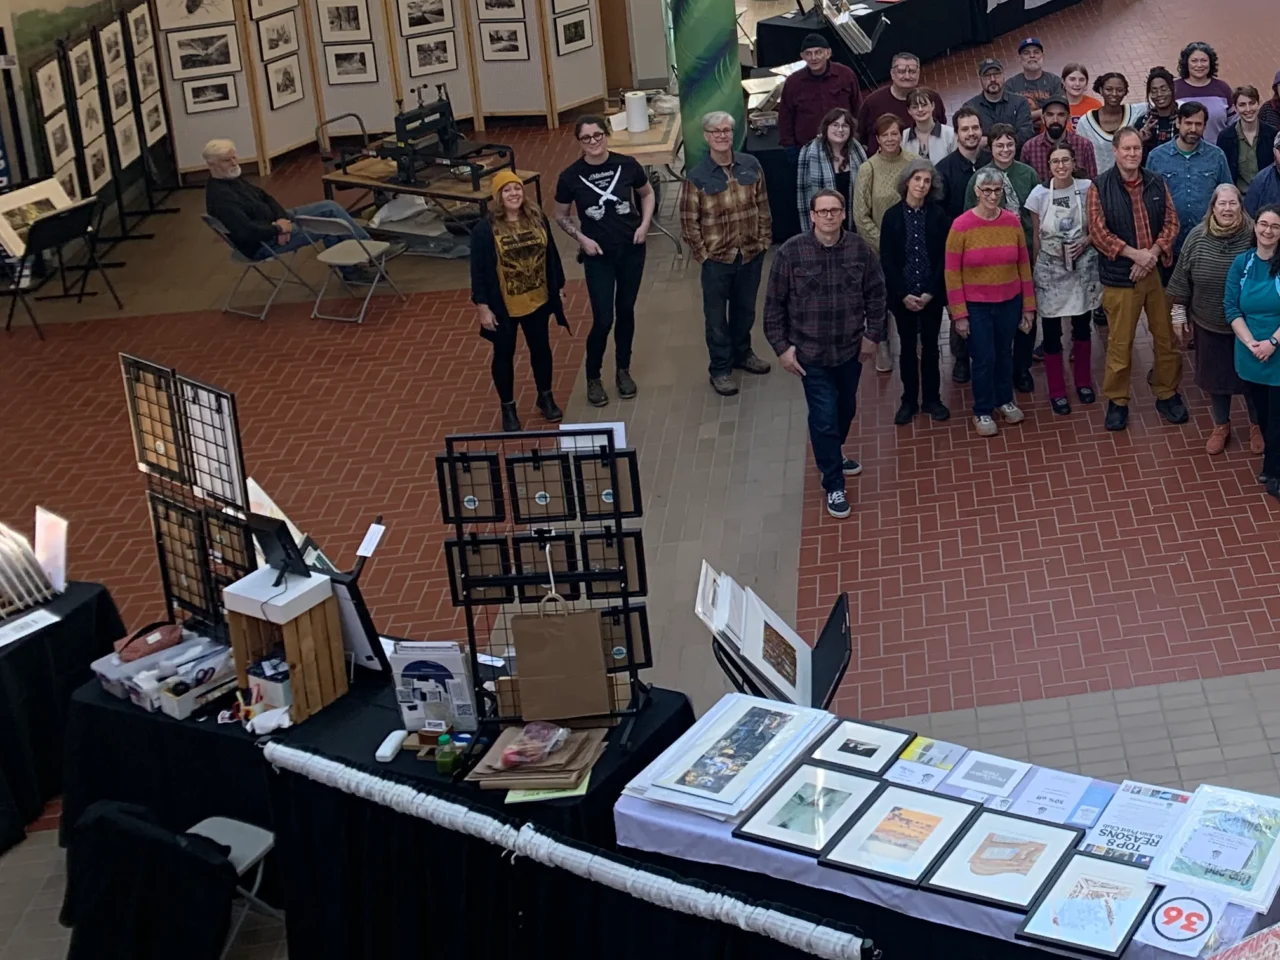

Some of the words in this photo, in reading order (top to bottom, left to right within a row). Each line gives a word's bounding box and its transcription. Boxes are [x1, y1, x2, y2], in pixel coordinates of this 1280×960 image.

[1121, 827, 1139, 835] Print
[1098, 828, 1160, 847] REASONS
[1106, 838, 1116, 846] 8
[1116, 841, 1141, 852] TOP
[1162, 906, 1205, 933] 36
